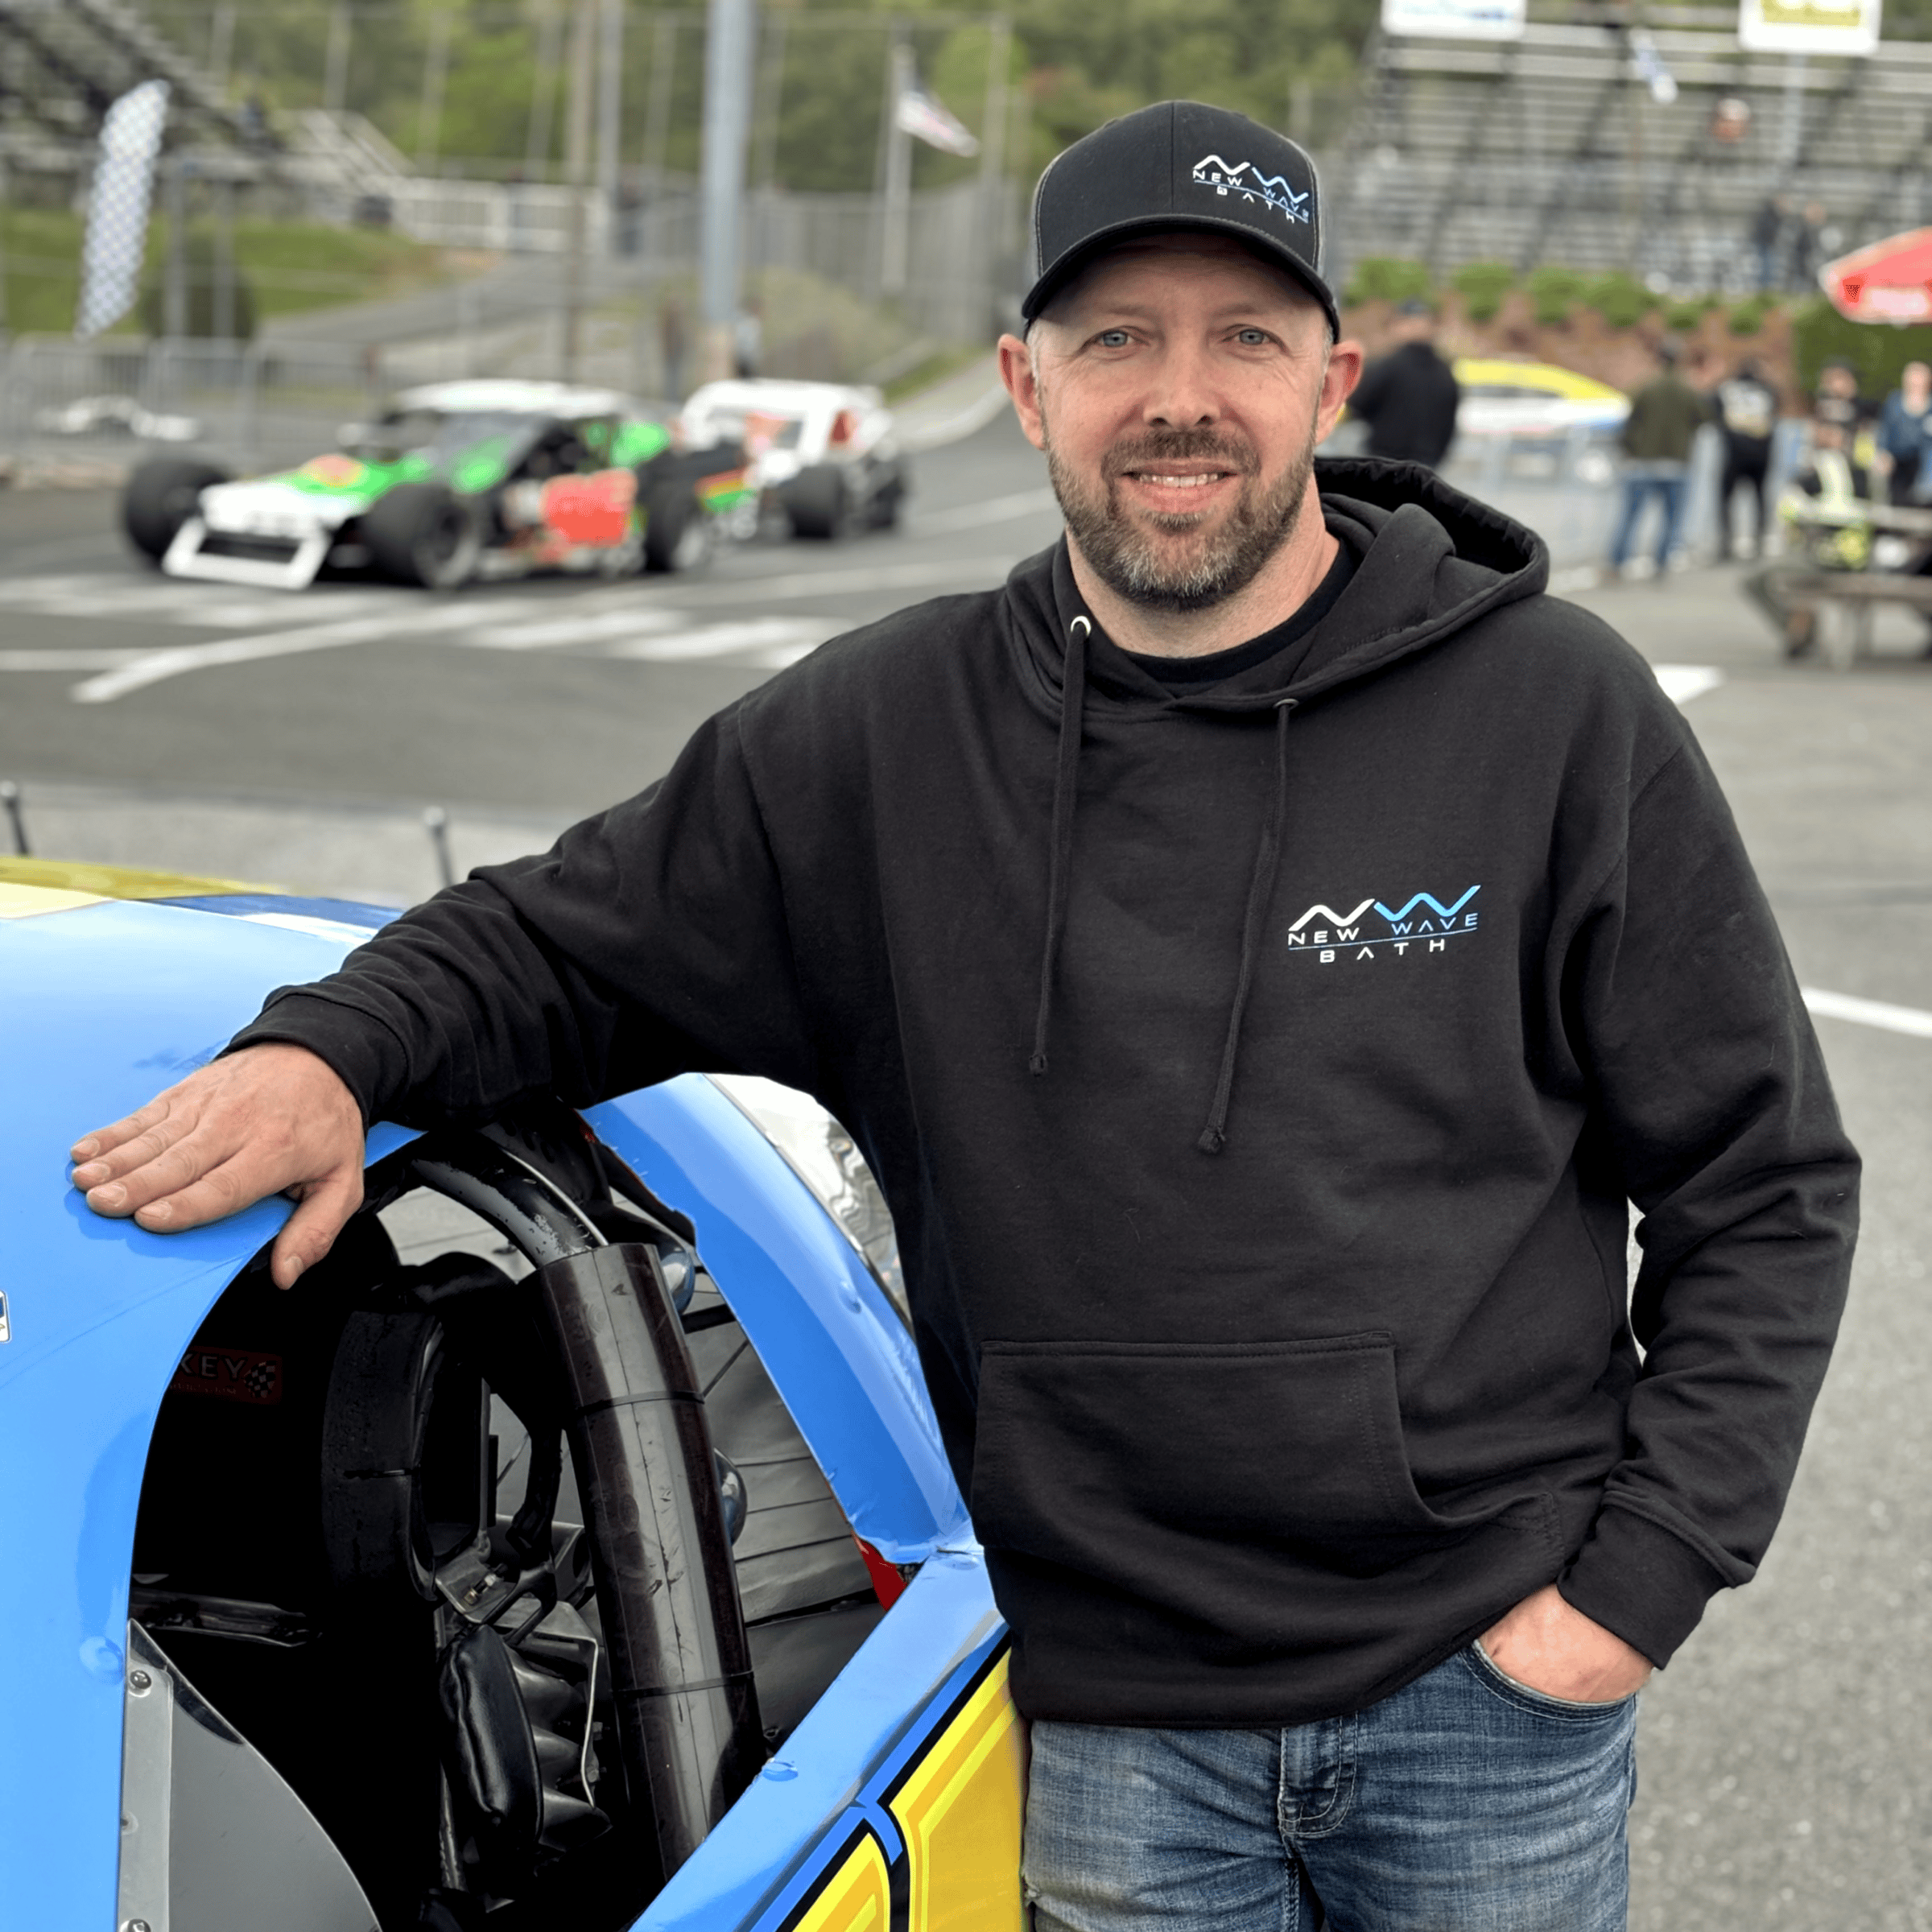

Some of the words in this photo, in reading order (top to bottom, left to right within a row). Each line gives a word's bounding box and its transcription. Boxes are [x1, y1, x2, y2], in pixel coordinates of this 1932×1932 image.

[1192, 169, 1242, 187] NEW
[1263, 187, 1309, 218] WAVE
[1216, 185, 1295, 224] BATH
[1288, 927, 1360, 946] NEW
[1391, 913, 1478, 935] WAVE
[1319, 939, 1445, 963] BATH
